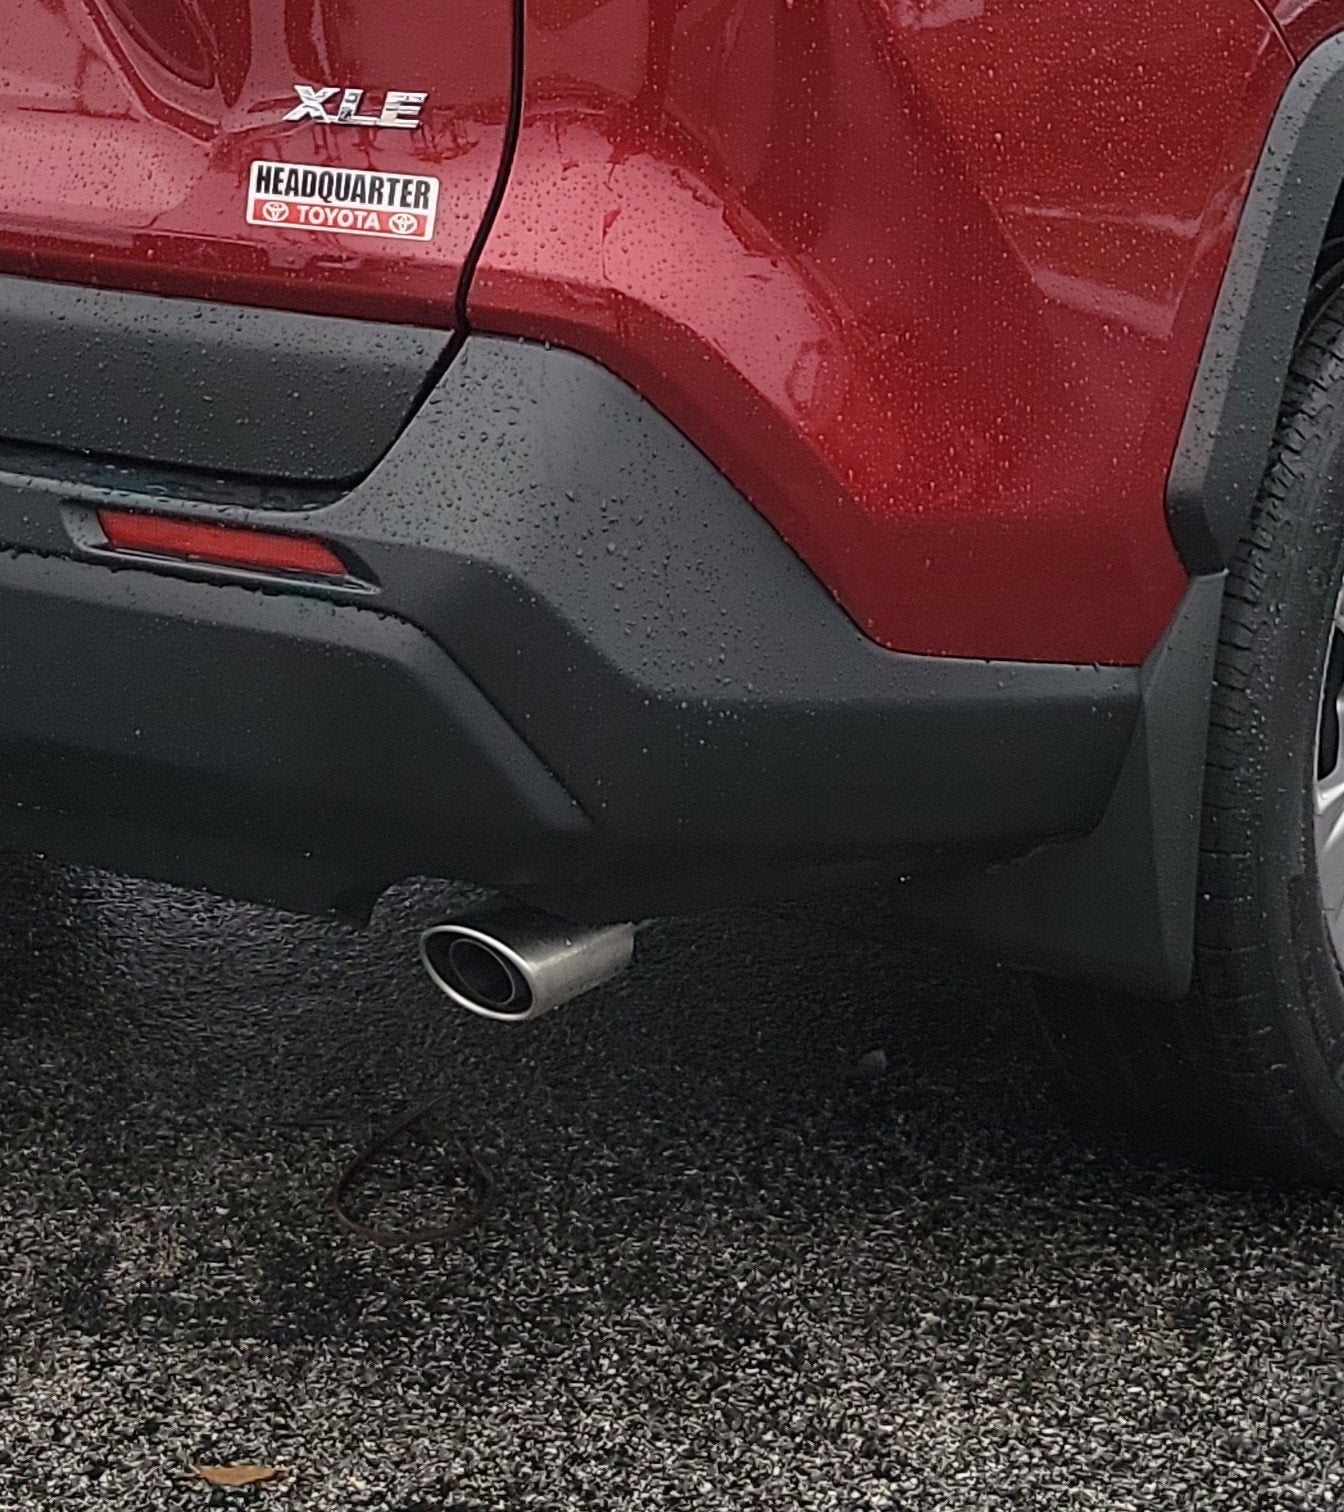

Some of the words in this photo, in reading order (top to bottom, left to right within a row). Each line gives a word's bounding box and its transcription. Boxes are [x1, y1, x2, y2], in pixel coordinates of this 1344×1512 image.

[282, 84, 429, 129] XLE
[255, 164, 431, 211] HEADQUARTER
[296, 204, 381, 231] TOYOTA
